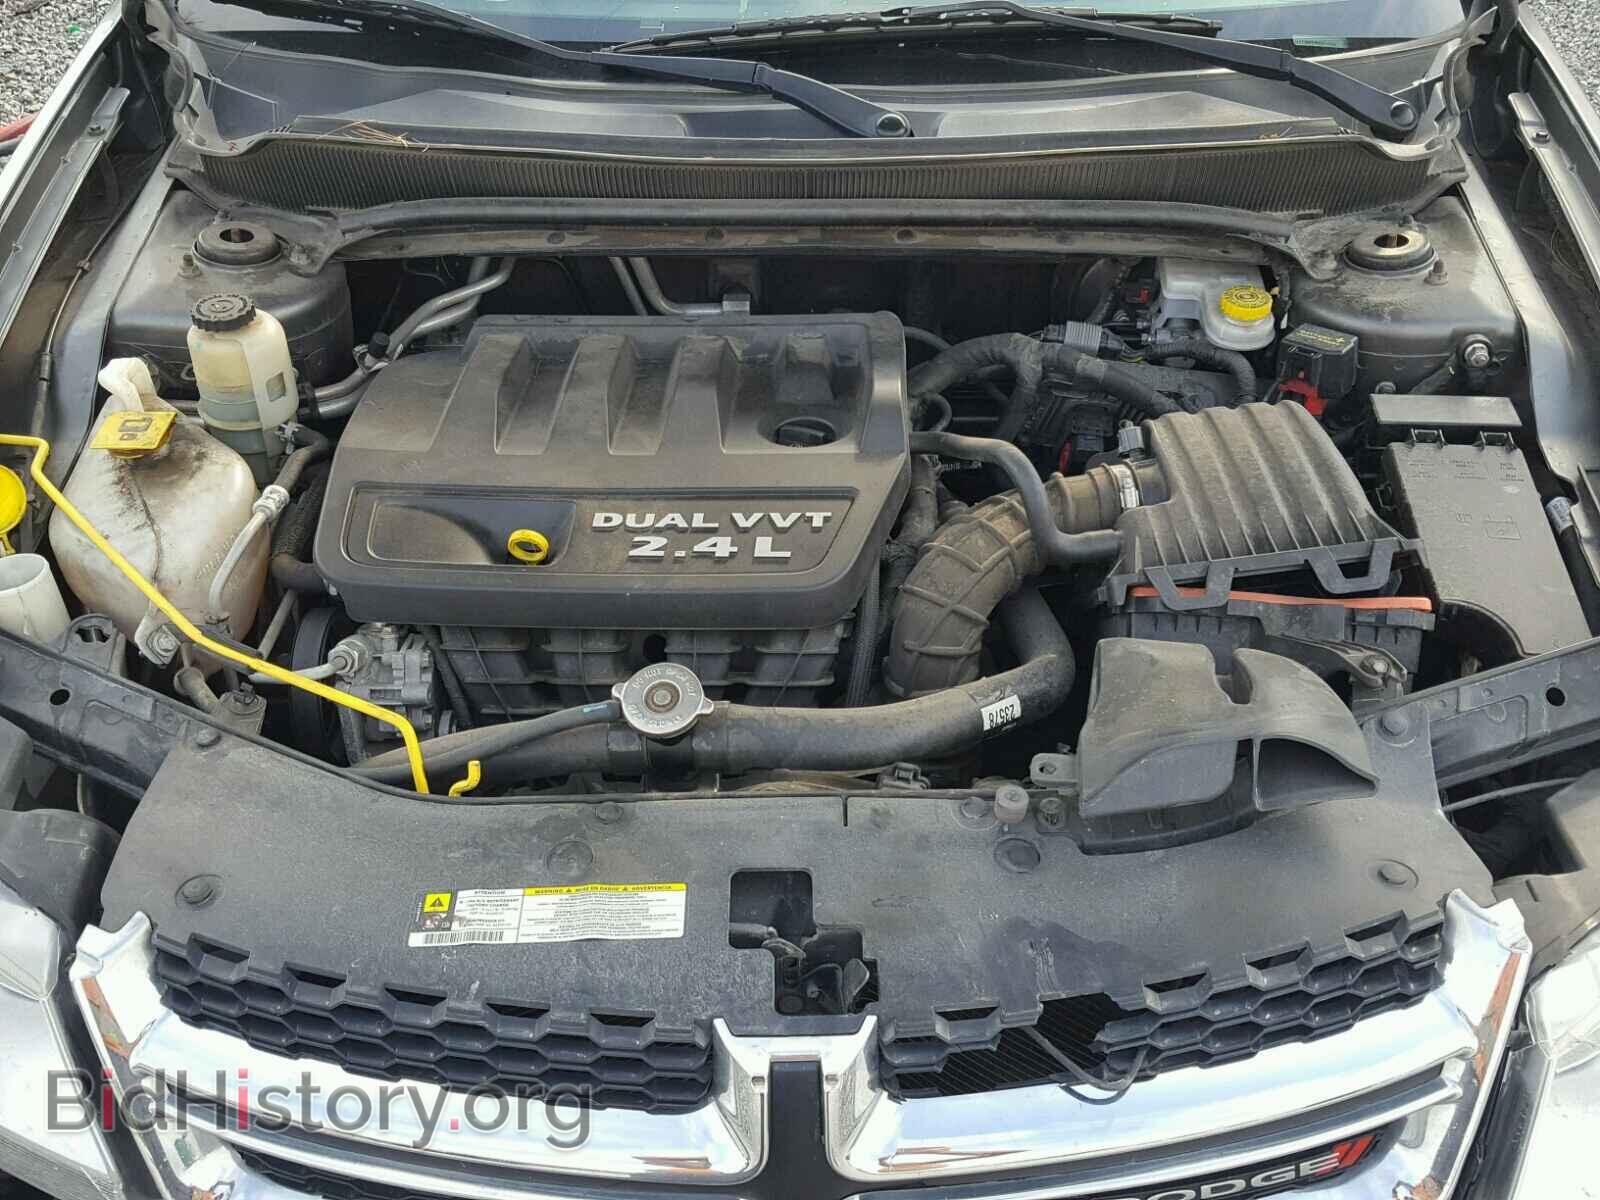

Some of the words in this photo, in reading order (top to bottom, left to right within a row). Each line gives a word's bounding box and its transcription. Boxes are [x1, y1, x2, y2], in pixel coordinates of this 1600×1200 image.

[591, 512, 720, 531] DUAL
[730, 511, 833, 531] VVT
[1115, 1151, 1341, 1200] ODGE
